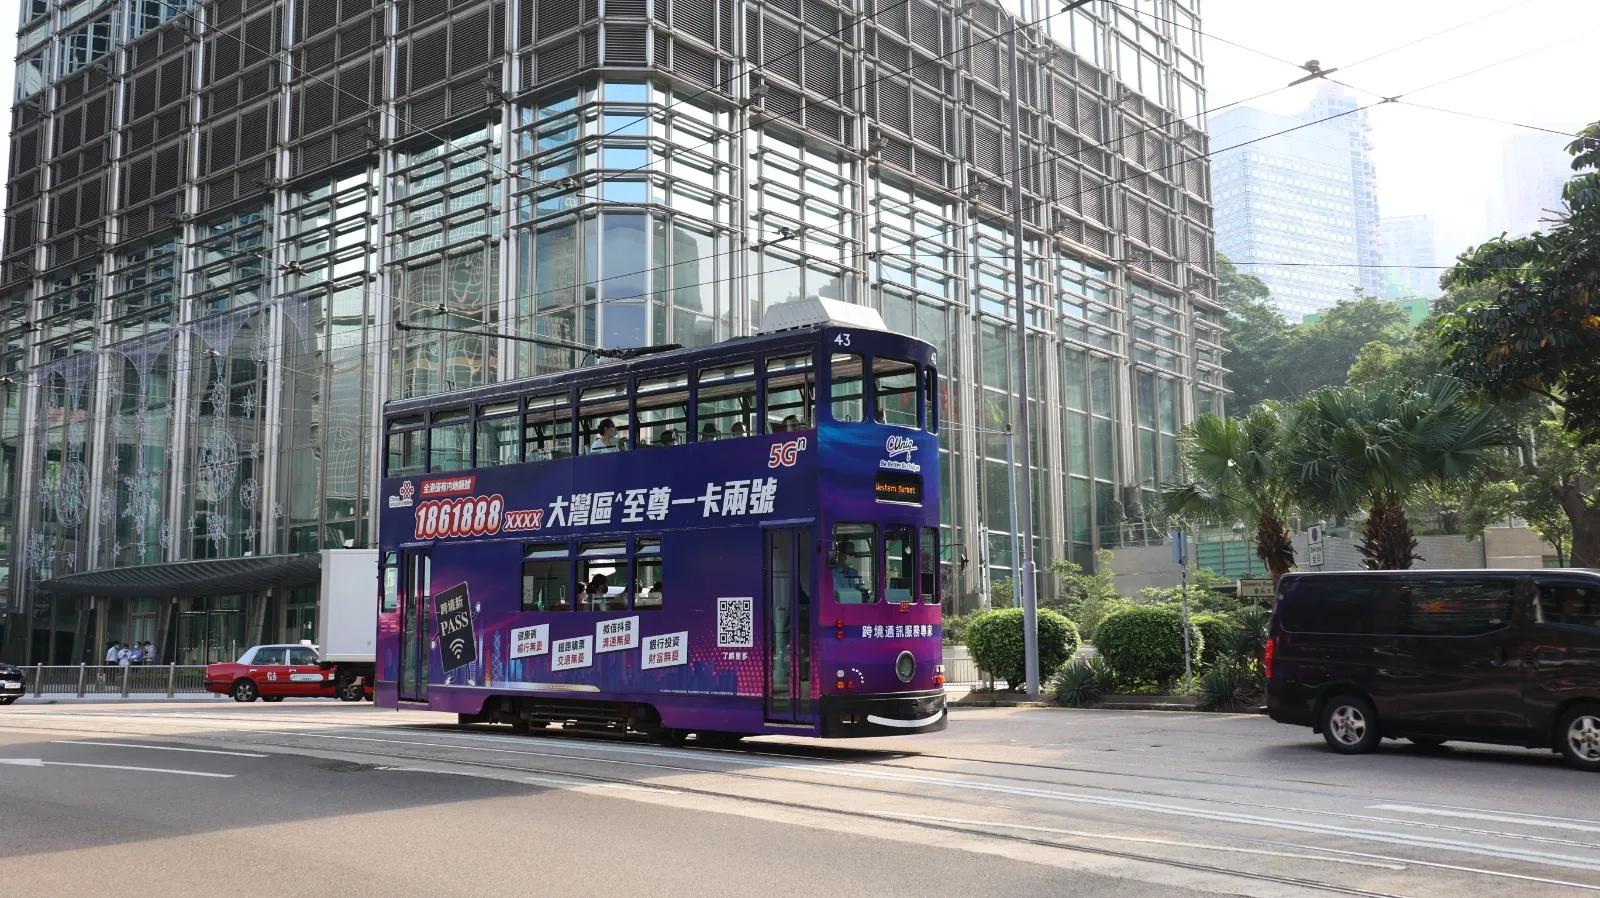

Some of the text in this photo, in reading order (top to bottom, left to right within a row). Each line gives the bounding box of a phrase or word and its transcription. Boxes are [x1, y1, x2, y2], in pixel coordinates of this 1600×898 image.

[834, 333, 851, 347] 43
[875, 483, 916, 494] Western Market
[415, 496, 503, 538] 1861888
[440, 612, 469, 637] PASS
[603, 620, 631, 634] 微信抖音
[862, 624, 933, 638] 跨境通訊服務專家
[649, 636, 680, 651] 銀行投資
